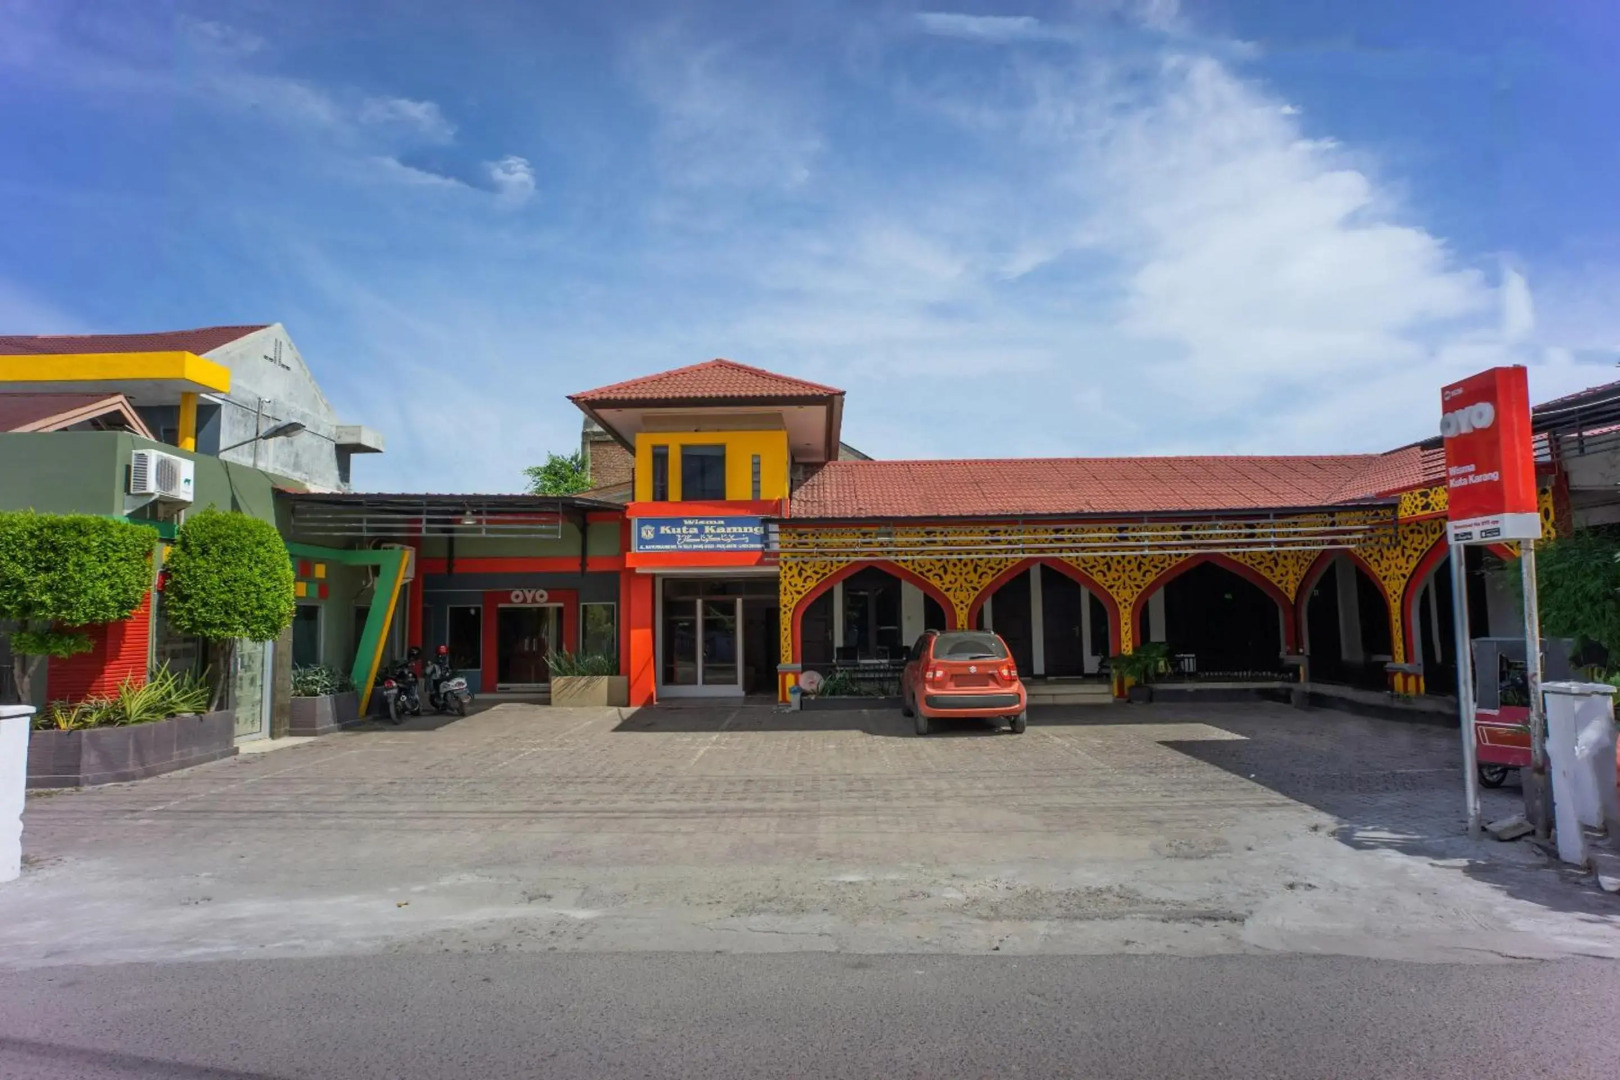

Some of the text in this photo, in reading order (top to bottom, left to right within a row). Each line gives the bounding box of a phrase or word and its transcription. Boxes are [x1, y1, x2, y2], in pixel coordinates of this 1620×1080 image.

[1440, 402, 1494, 437] OYO
[1449, 464, 1476, 476] Wisma
[660, 526, 699, 534] Kuta
[511, 588, 548, 603] OYO
